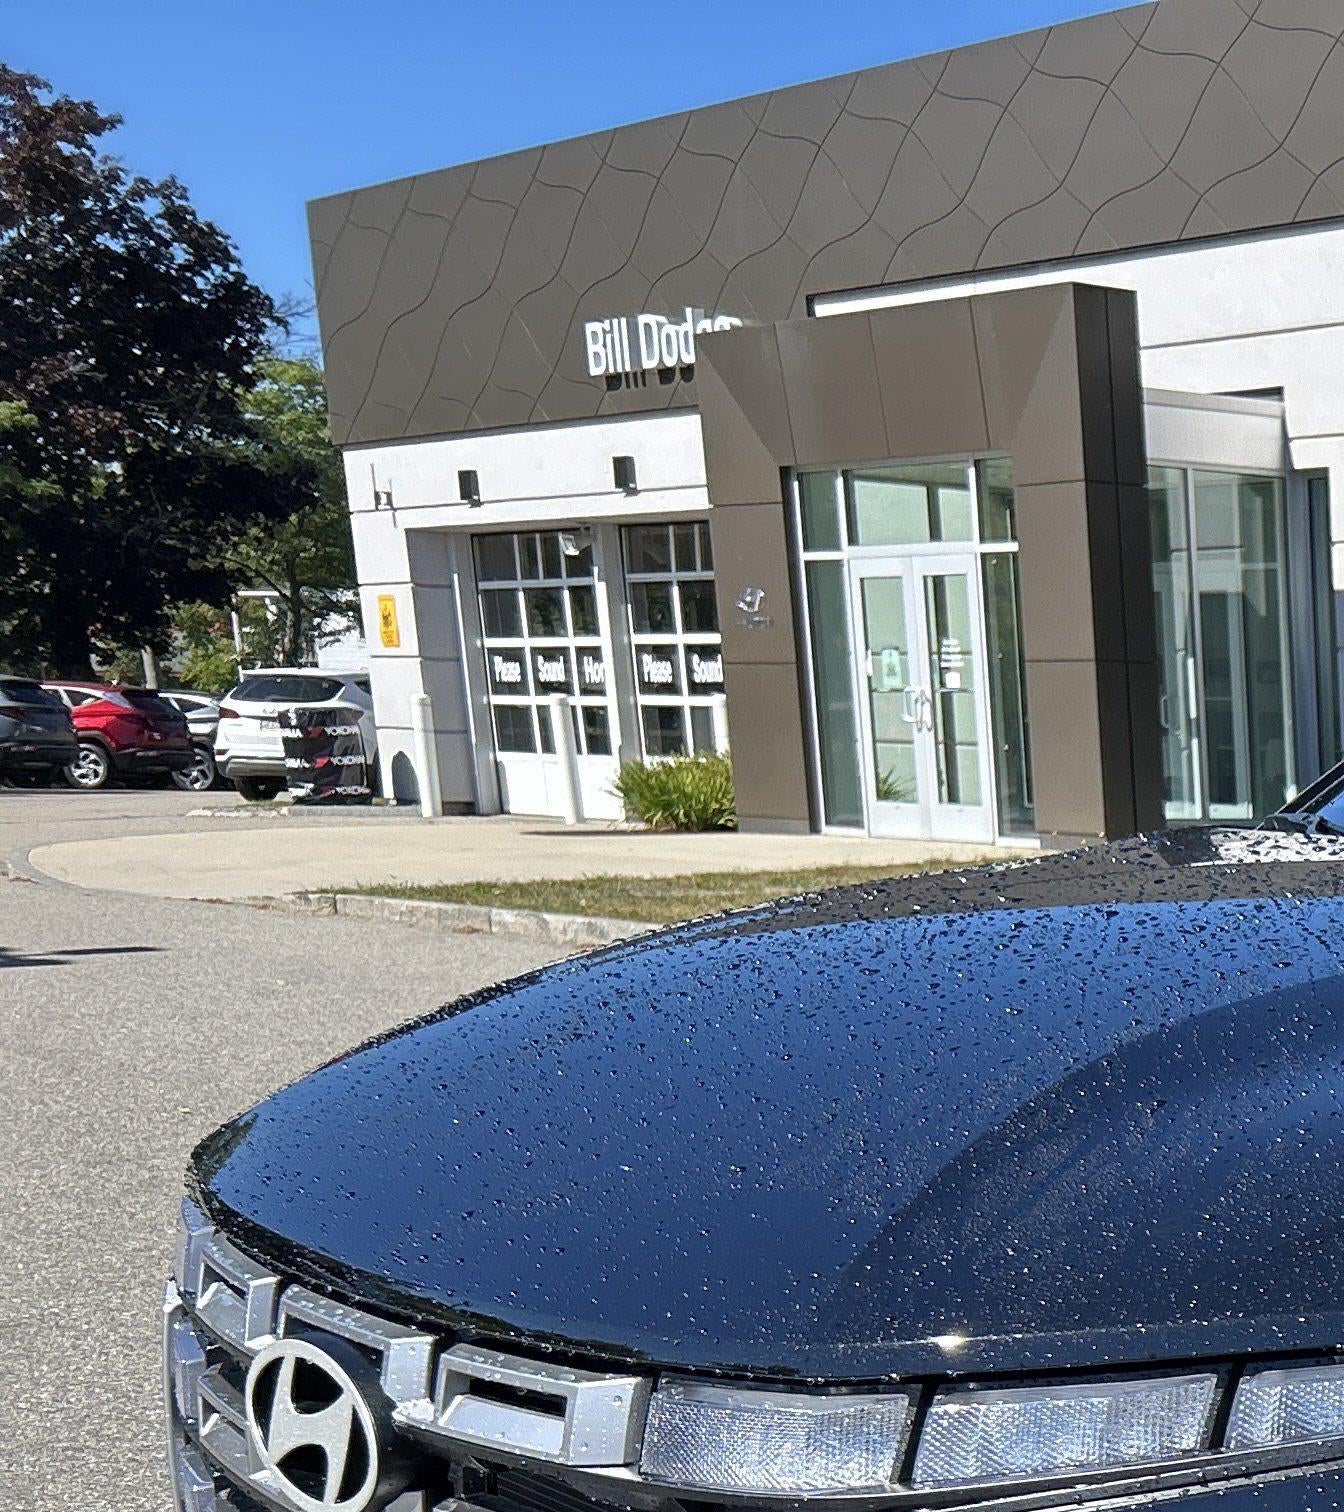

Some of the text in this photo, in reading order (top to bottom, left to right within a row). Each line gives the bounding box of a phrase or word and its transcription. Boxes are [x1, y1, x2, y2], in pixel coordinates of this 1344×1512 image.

[585, 307, 743, 377] Bill Dod
[493, 655, 522, 683] Please
[537, 655, 566, 683] Sound
[642, 653, 724, 683] Please Sound
